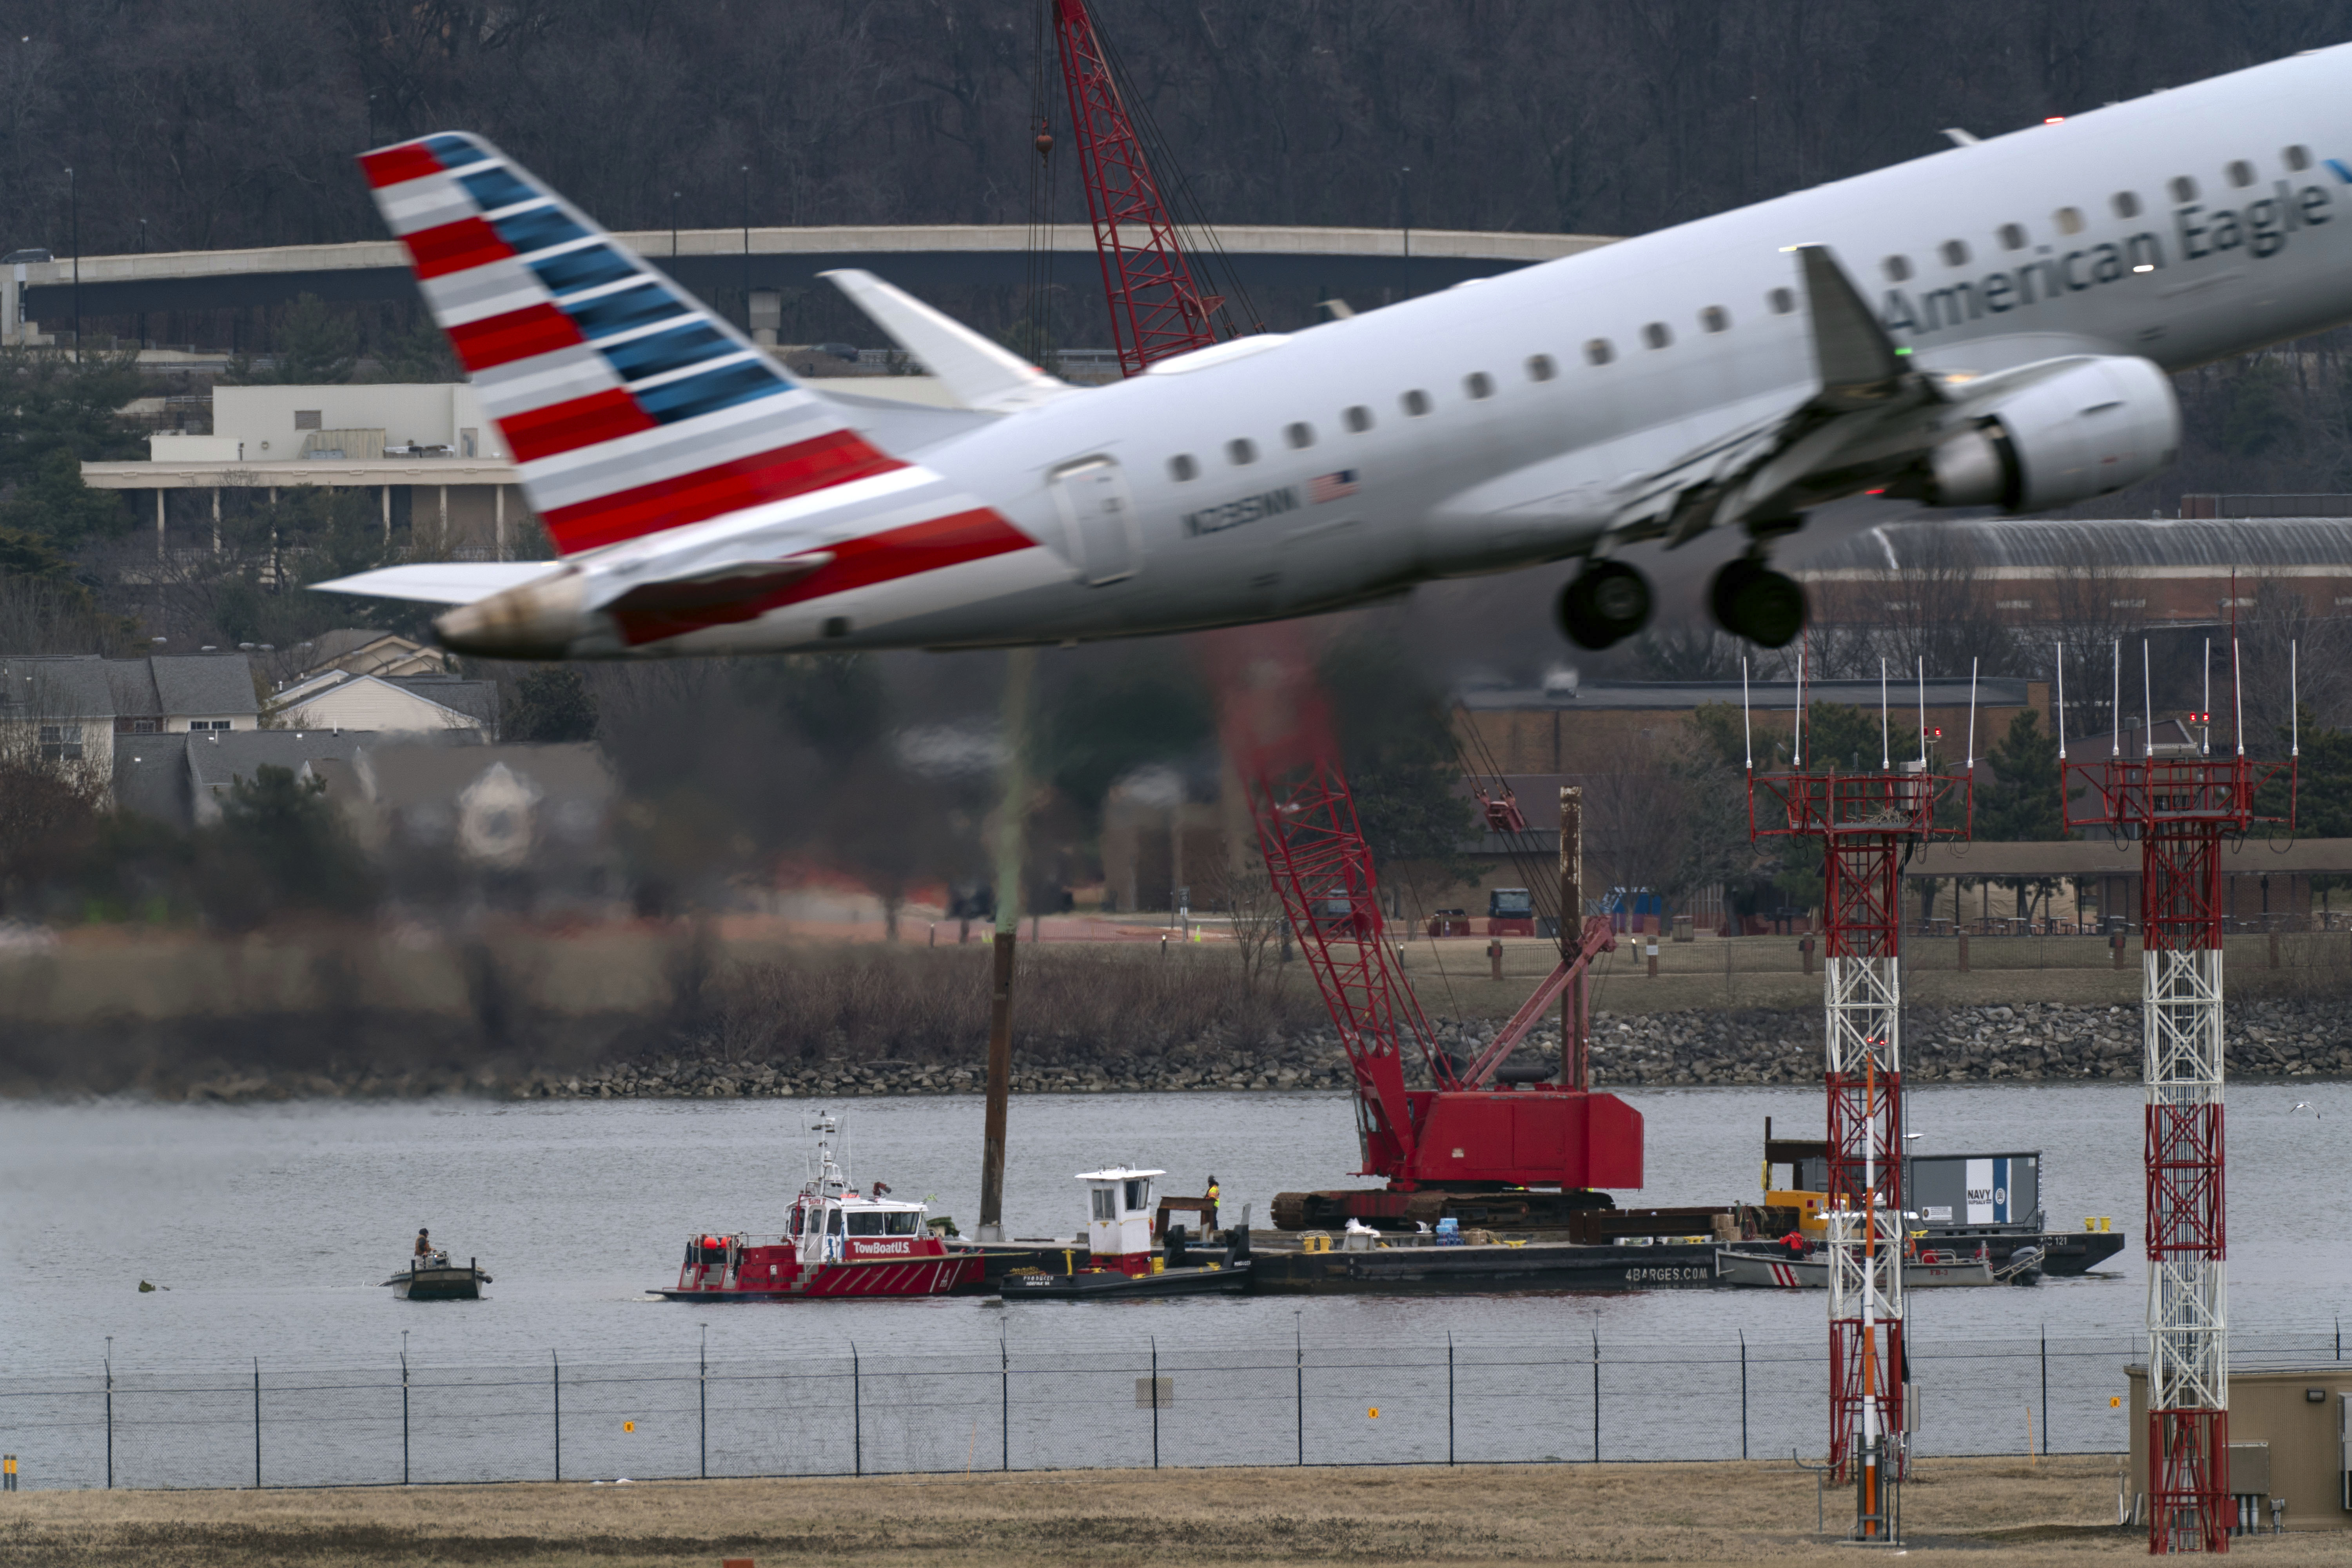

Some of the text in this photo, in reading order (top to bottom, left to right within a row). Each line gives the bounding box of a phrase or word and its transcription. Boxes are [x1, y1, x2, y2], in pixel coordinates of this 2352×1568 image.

[1884, 180, 2333, 337] American Eagle
[1968, 1189, 1991, 1199] NAVY
[2055, 1236, 2067, 1245] 121
[853, 1241, 910, 1254] TowBoatU.S.
[1625, 1267, 1708, 1281] 4BARGES.COM
